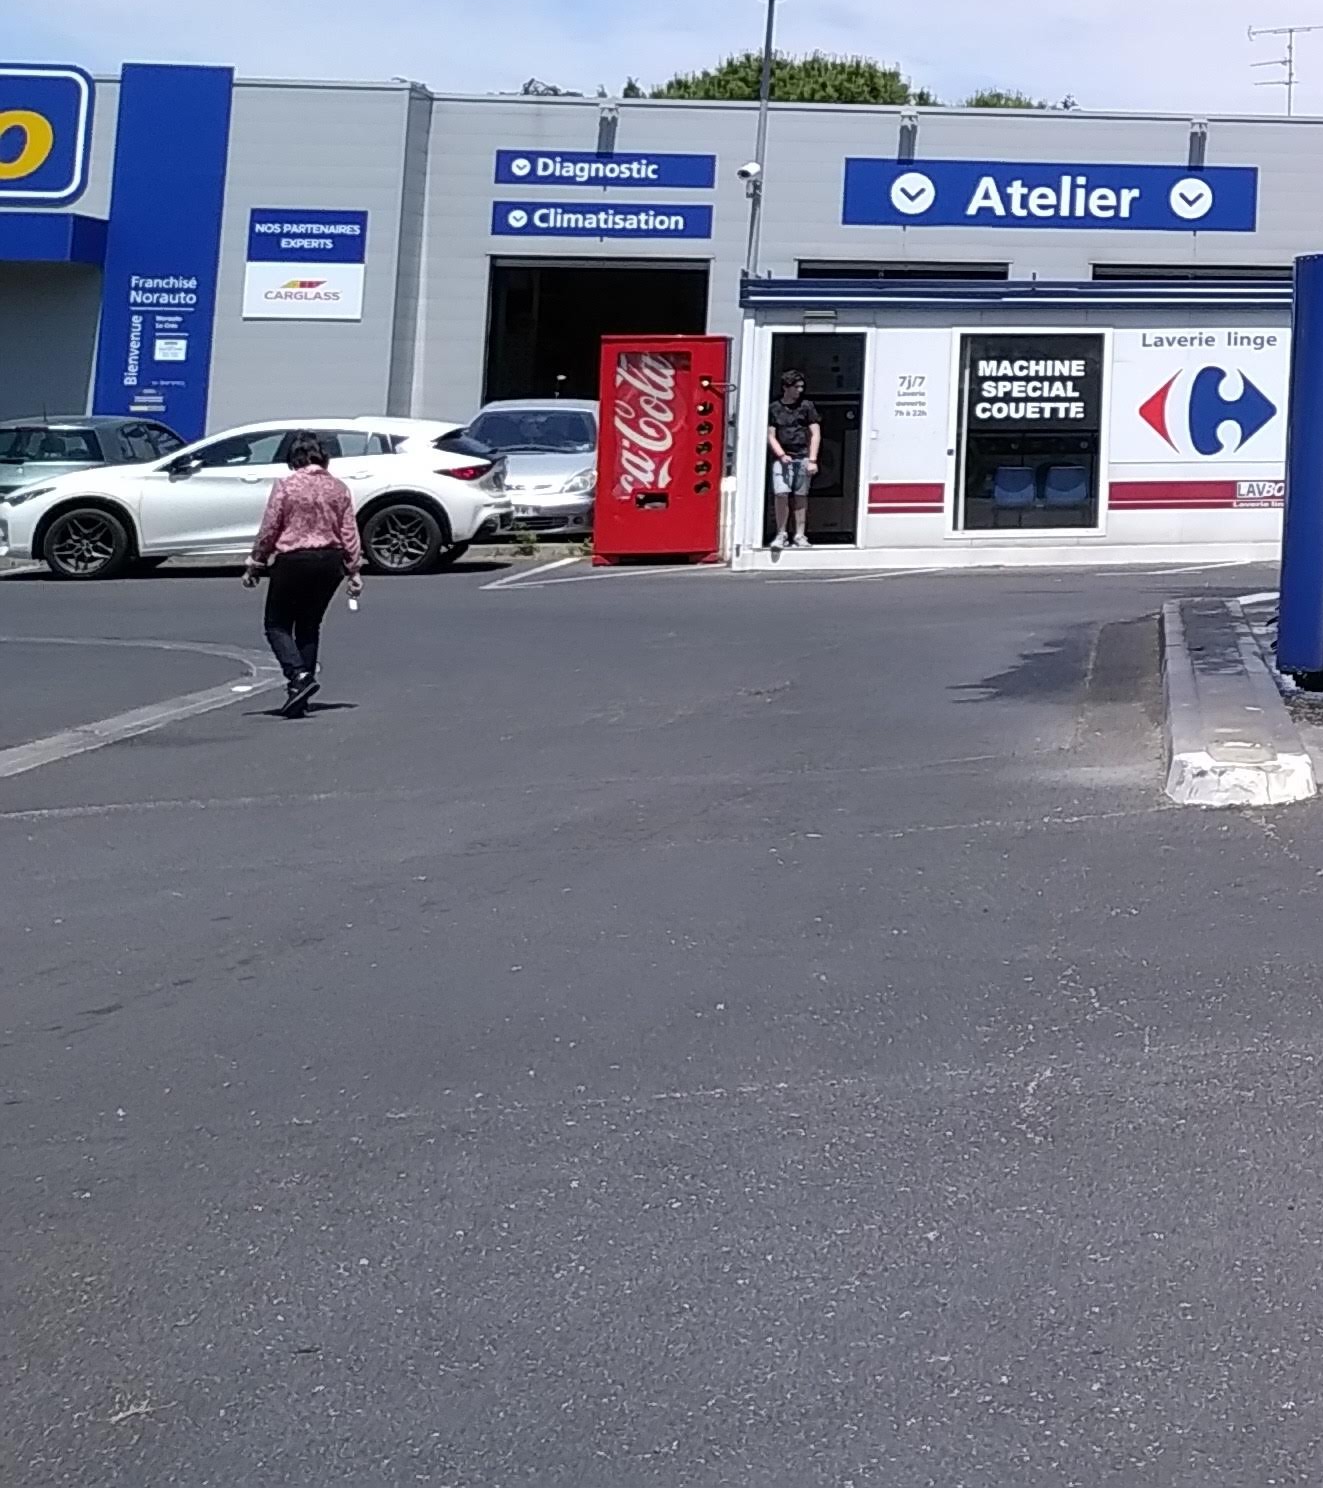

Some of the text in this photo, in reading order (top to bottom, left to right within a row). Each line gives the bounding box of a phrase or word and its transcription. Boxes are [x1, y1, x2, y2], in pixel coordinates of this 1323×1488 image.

[536, 156, 659, 182] Diagnostic
[965, 175, 1140, 218] Atelier
[533, 208, 684, 230] Climatisation
[255, 223, 361, 235] NOS PARTENAIRES
[281, 238, 334, 249] EXPERTS
[130, 275, 198, 288] Franchisé
[129, 290, 197, 304] Norauto
[264, 290, 341, 301] CARGLASS
[1141, 331, 1278, 350] Laverie linge
[123, 314, 144, 386] Bienvenue
[977, 360, 1086, 377] MACHINE
[898, 375, 926, 390] 7j/7
[981, 380, 1080, 398] SPECIAL
[975, 401, 1085, 419] COUETTE
